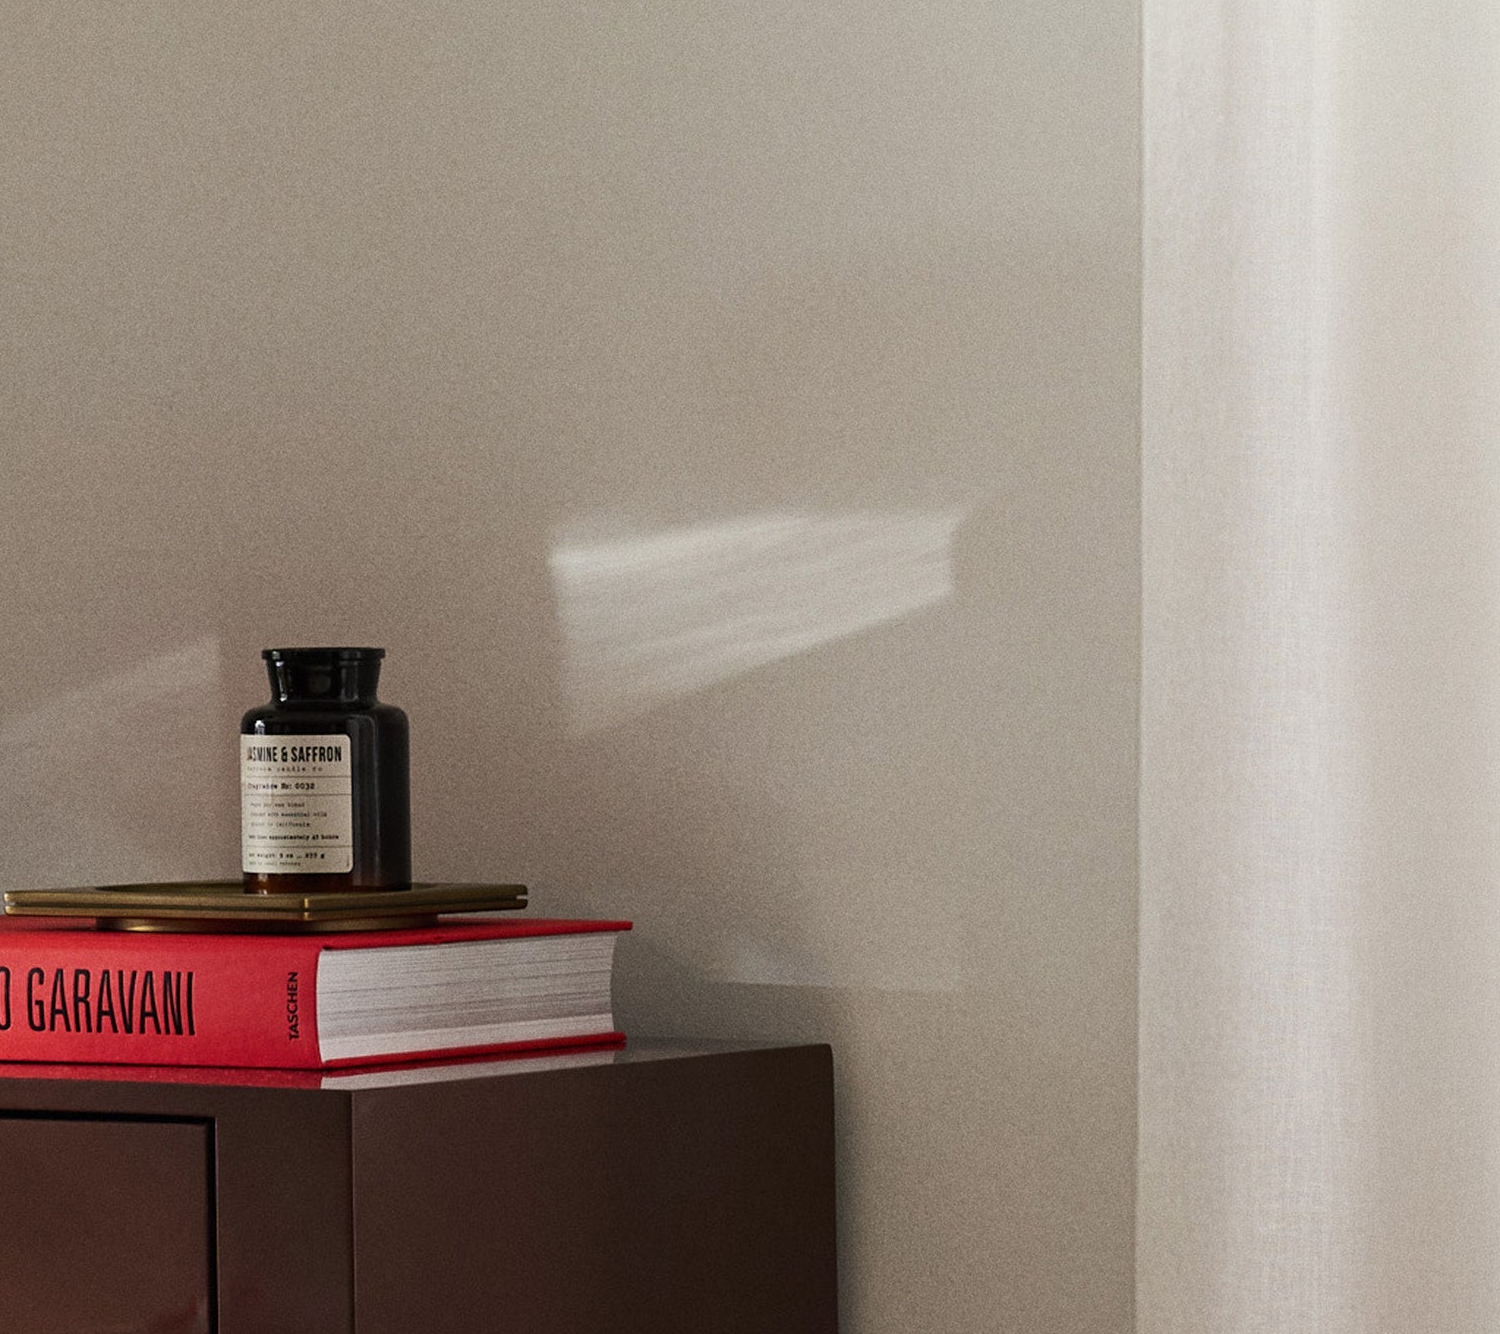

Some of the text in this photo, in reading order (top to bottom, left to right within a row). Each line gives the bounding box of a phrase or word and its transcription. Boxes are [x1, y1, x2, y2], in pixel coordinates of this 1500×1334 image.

[281, 746, 288, 762] &
[291, 746, 342, 762] SAFFRON
[26, 966, 196, 1036] GARAVANI
[287, 971, 300, 1041] TASCHEN
